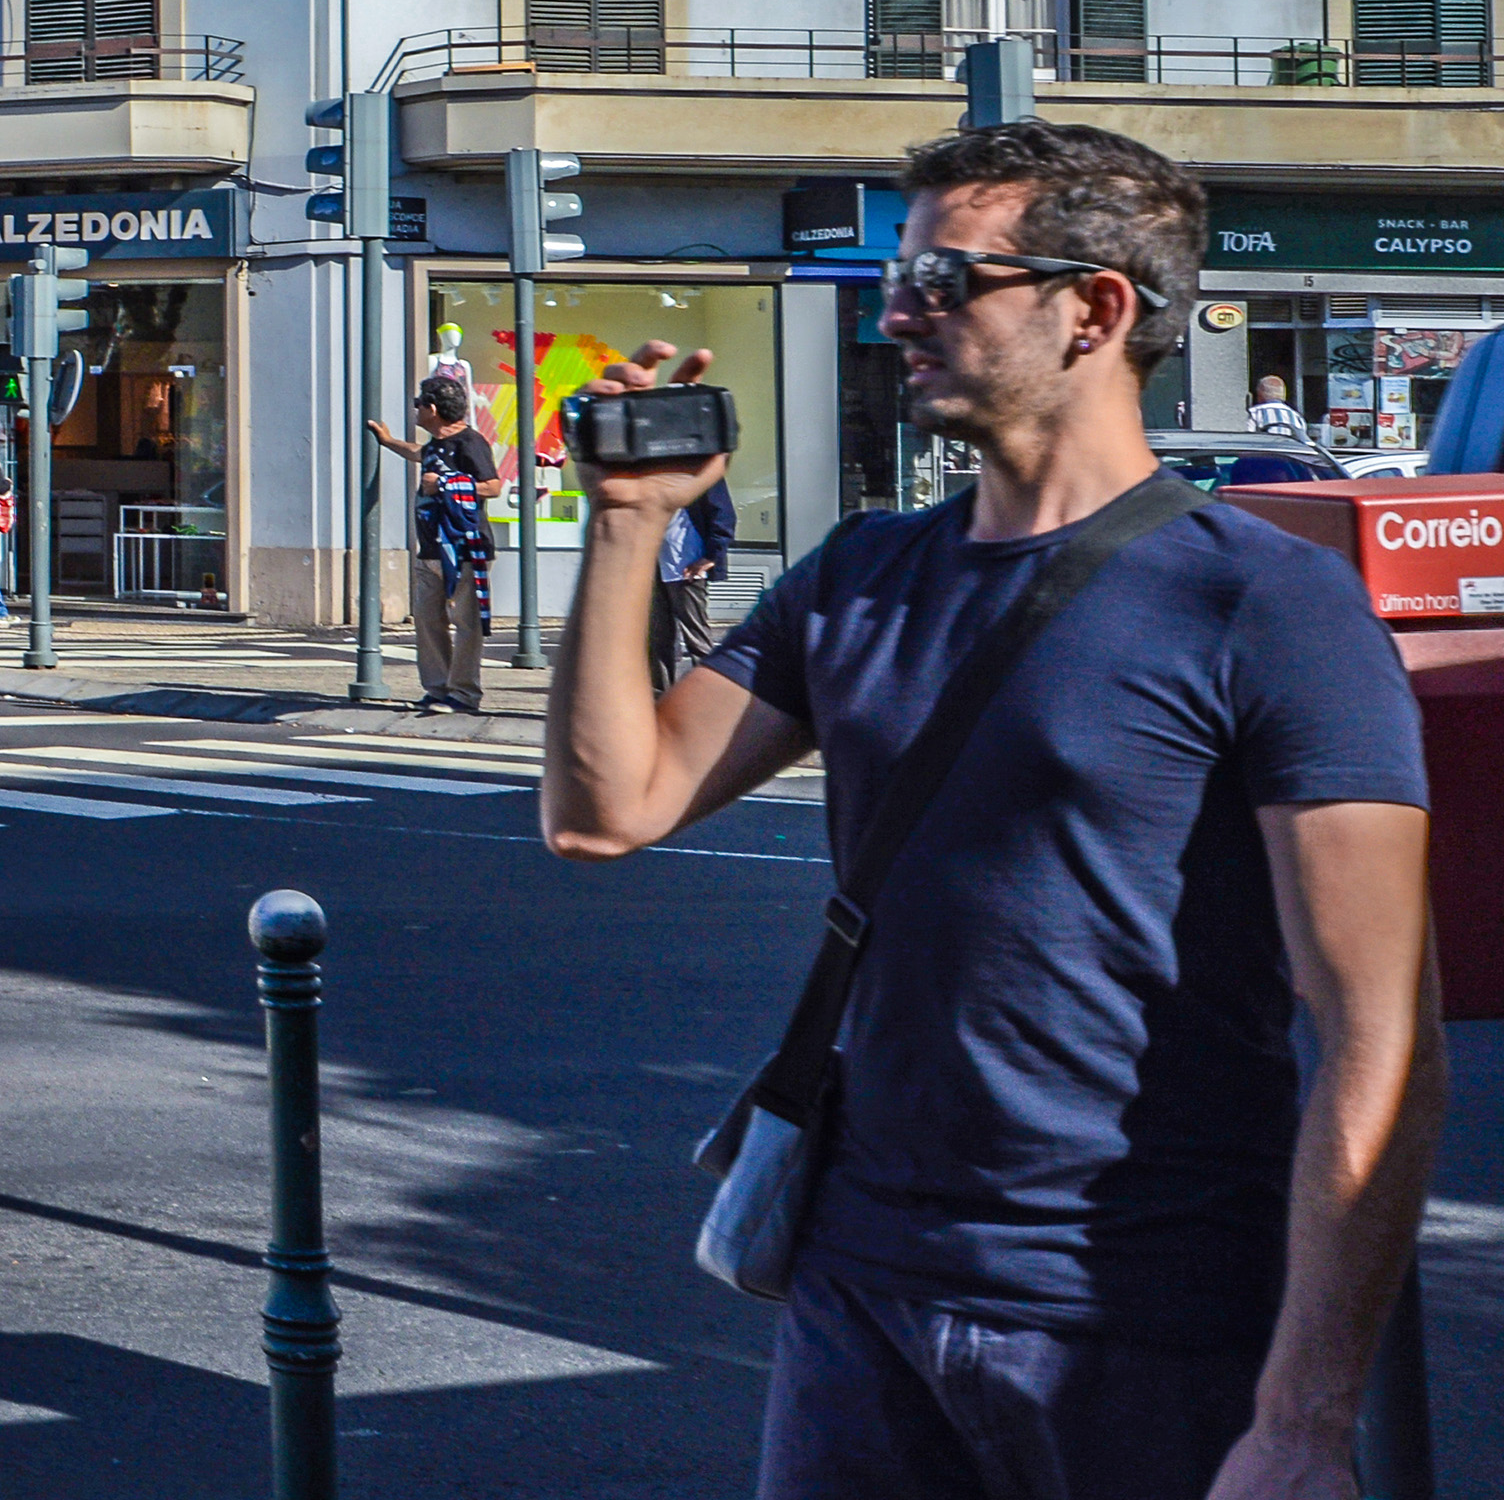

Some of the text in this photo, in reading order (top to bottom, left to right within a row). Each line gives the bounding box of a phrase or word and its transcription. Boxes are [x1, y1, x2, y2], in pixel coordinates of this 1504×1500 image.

[1378, 219, 1425, 229] SNACK
[1440, 219, 1469, 230] BAR
[792, 226, 855, 241] CALZEDONIA
[1218, 231, 1278, 252] TOFA
[1375, 237, 1472, 254] CALYPSO
[1304, 275, 1314, 288] 15
[1376, 508, 1503, 551] Correio
[1379, 593, 1425, 612] última
[1425, 593, 1460, 610] hora
